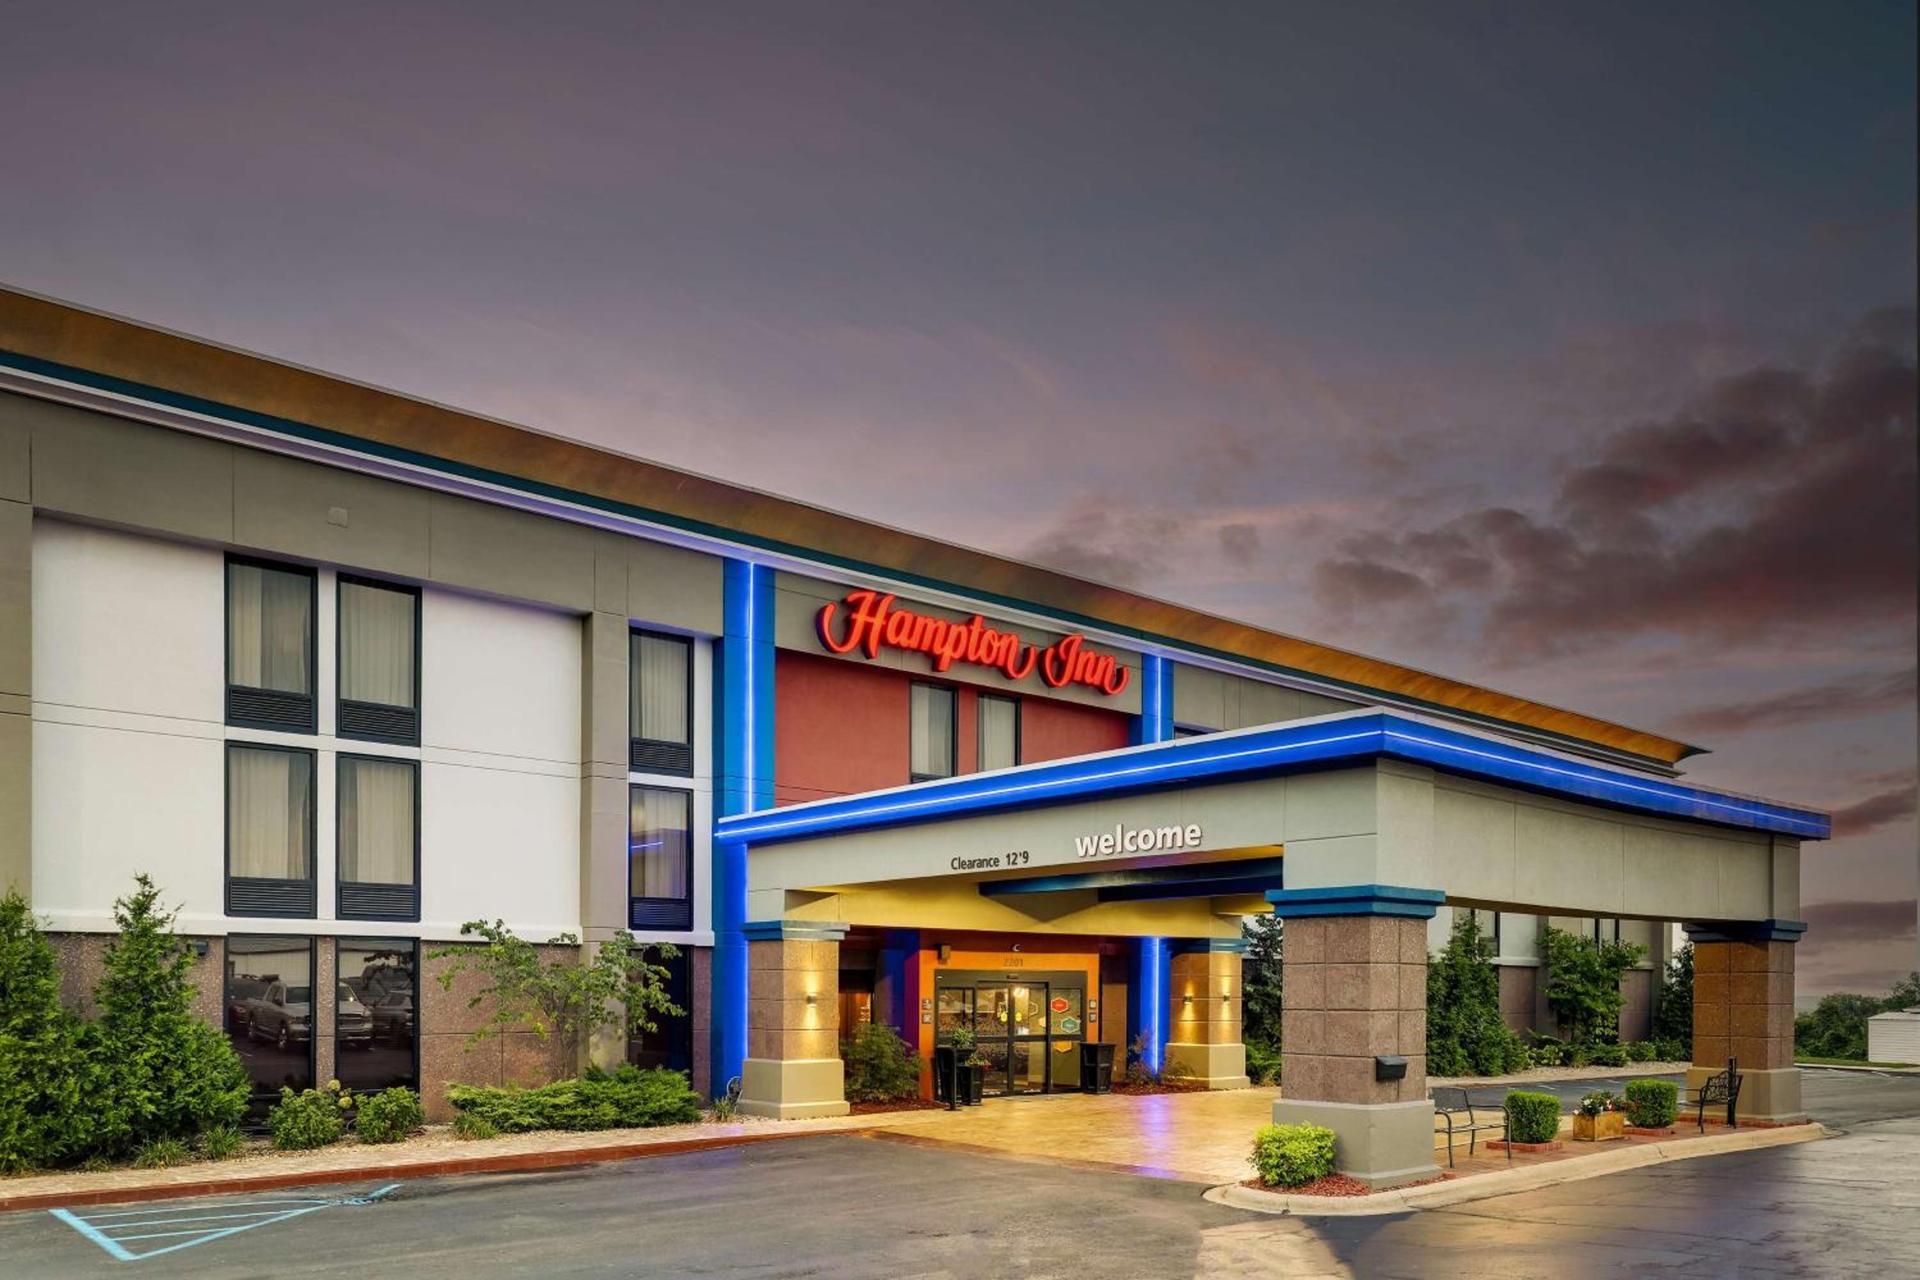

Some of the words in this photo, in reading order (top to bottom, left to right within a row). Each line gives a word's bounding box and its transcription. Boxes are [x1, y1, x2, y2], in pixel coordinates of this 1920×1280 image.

[816, 591, 1036, 680] Hampton
[1039, 633, 1129, 695] Inn
[1075, 823, 1202, 857] welcome
[951, 856, 1000, 871] Clearance
[1005, 851, 1030, 866] 12'9
